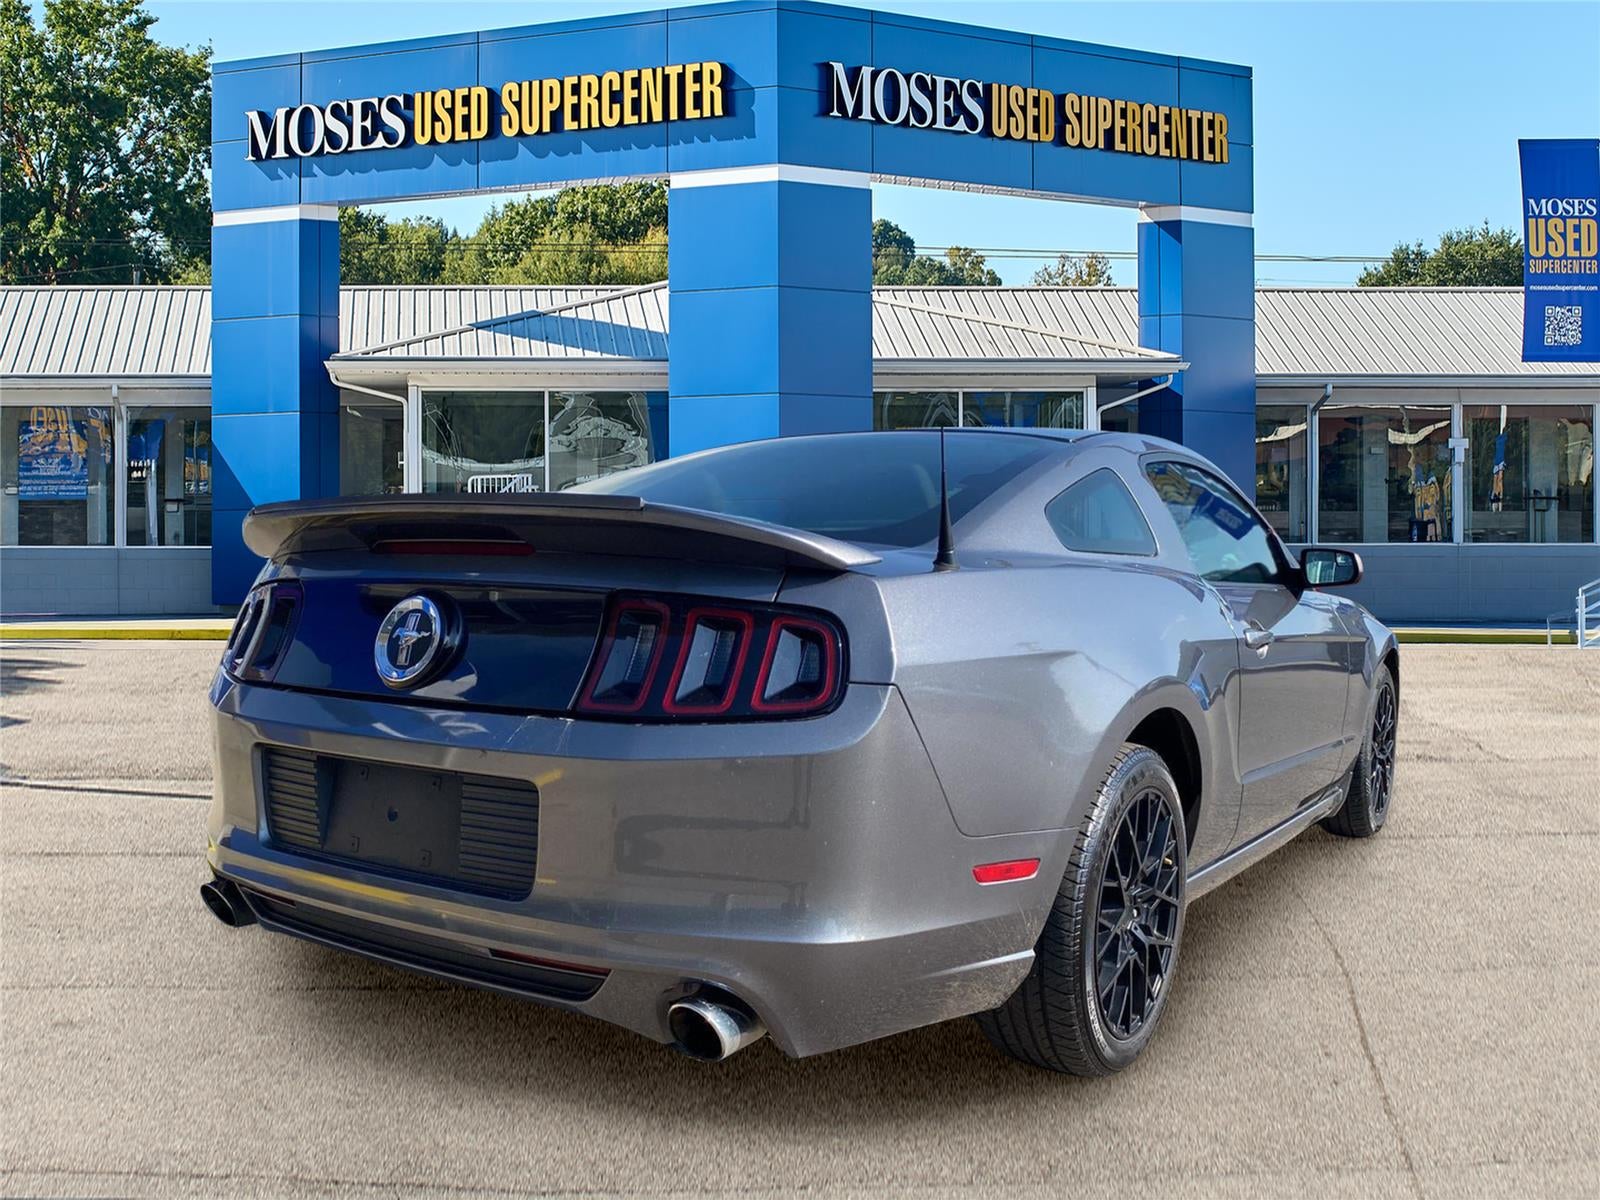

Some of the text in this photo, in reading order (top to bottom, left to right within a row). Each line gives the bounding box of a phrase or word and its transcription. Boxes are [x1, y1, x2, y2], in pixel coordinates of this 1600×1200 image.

[245, 61, 724, 161] MOSES USED SUPERCENTER
[829, 61, 1229, 163] MOSES USED SUPERCENTER
[1528, 198, 1597, 216] MOSES
[1528, 218, 1598, 257] USED
[1529, 259, 1598, 274] SUPERCENTER
